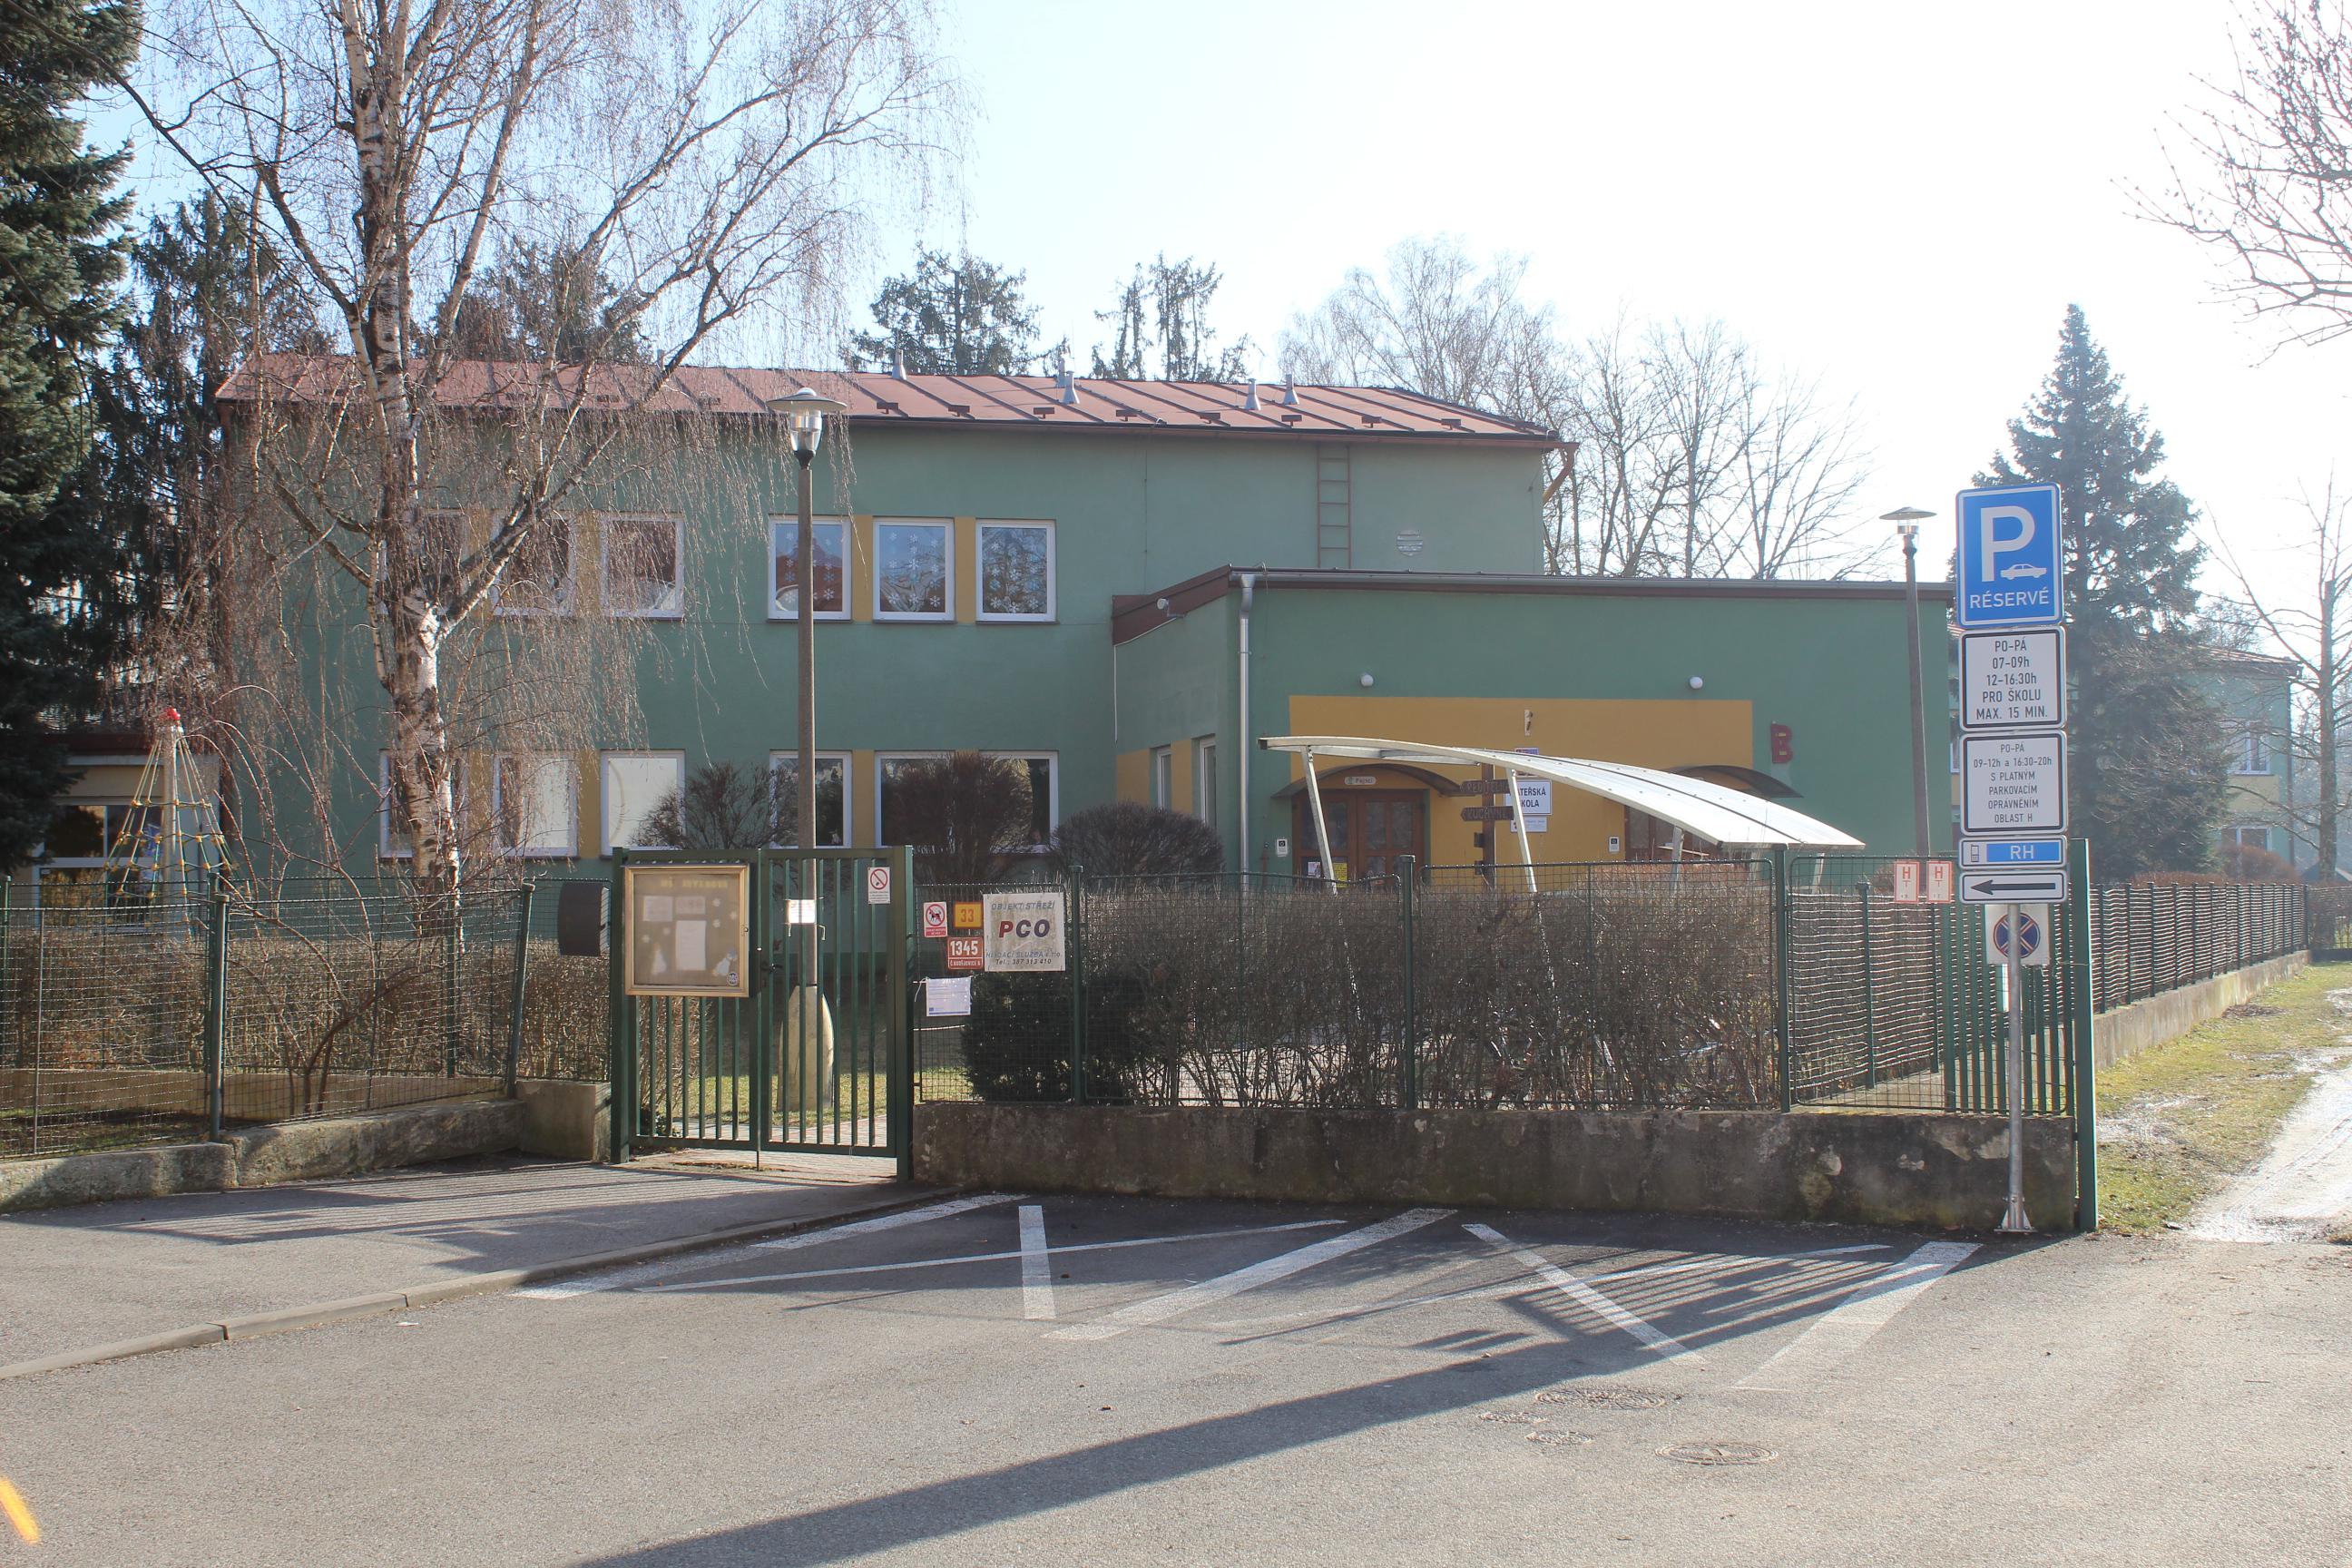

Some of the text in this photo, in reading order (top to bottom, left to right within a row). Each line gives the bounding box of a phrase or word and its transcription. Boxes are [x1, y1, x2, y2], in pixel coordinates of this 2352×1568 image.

[1980, 505, 2035, 583] P
[1969, 586, 2050, 609] RÉSERVÉ
[1994, 636, 2027, 652] PO-PÁ
[1992, 656, 2030, 669] 07-09h
[1986, 672, 2037, 686] 12-16:30h
[1982, 687, 2041, 703] PRO ŠKOLU
[1976, 705, 2048, 720] MAX. 15 MIN.
[2000, 740, 2025, 753] PO-PÁ
[1974, 759, 2001, 769] 09-12h
[2014, 756, 2053, 767] 16:30-20h
[1990, 769, 2035, 781] S PLATNÝM
[1517, 786, 1546, 796] TEŘSKÁ
[1988, 783, 2038, 795] PARKOVACÍM
[1521, 799, 1540, 808] KOLA
[1987, 797, 2039, 809] OPRÁVNĚNÍM
[1994, 813, 2033, 823] OBLAST H
[2010, 845, 2034, 860] RH
[1902, 866, 1911, 879] H
[1935, 866, 1944, 879] H
[1025, 900, 1056, 910] STŘEŽÍ
[960, 908, 975, 923] 33
[998, 919, 1051, 938] PCO
[950, 940, 978, 956] 1345
